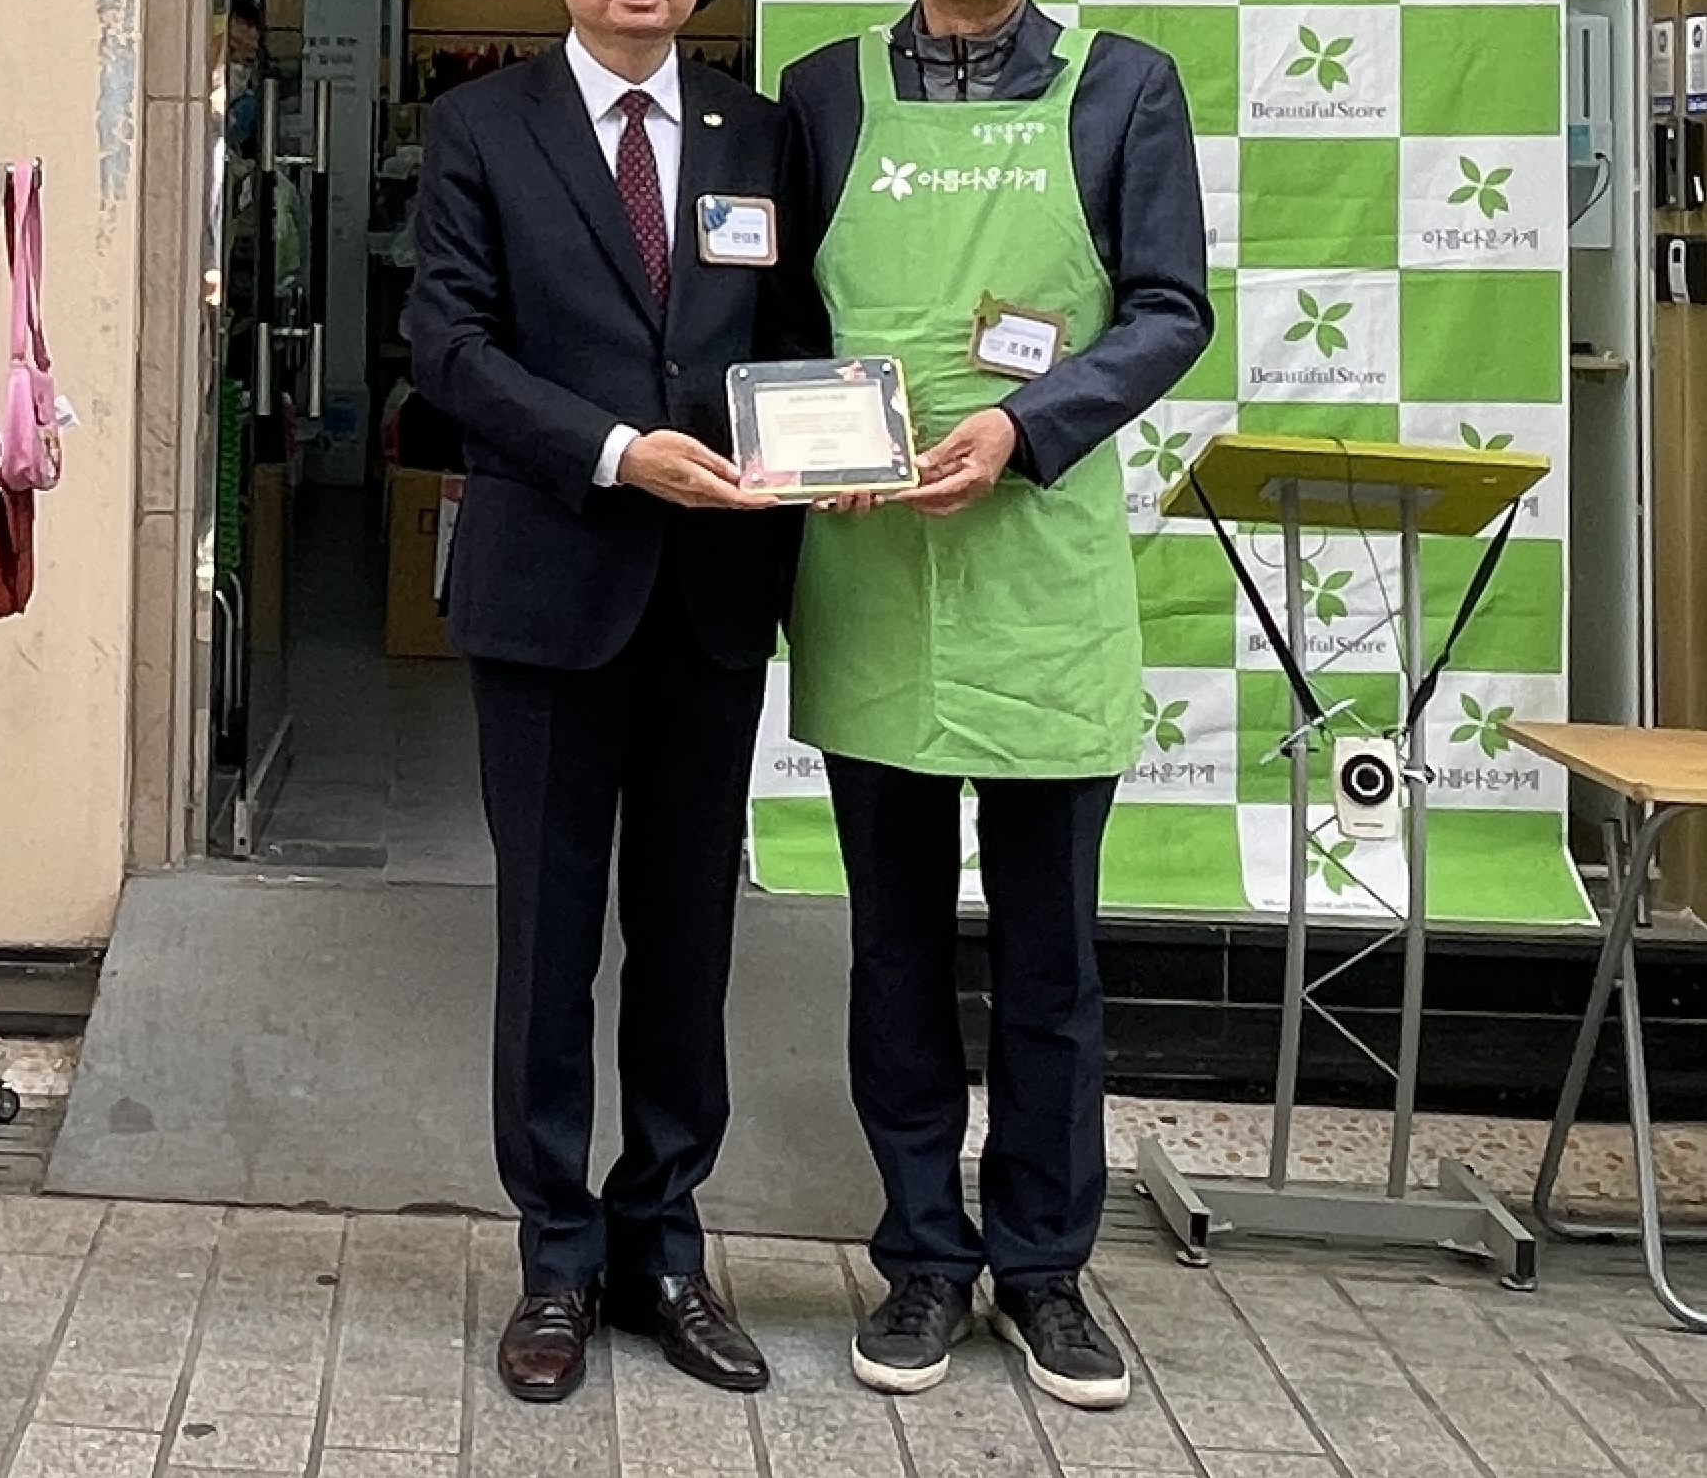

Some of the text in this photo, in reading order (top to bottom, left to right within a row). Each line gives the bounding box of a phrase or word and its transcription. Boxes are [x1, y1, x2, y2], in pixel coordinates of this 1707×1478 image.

[1250, 101, 1387, 119] BeautifulStore
[917, 165, 1048, 194] 아름다운가게
[1422, 228, 1539, 250] 아름다운가게
[1250, 366, 1387, 385] BeautifulStore
